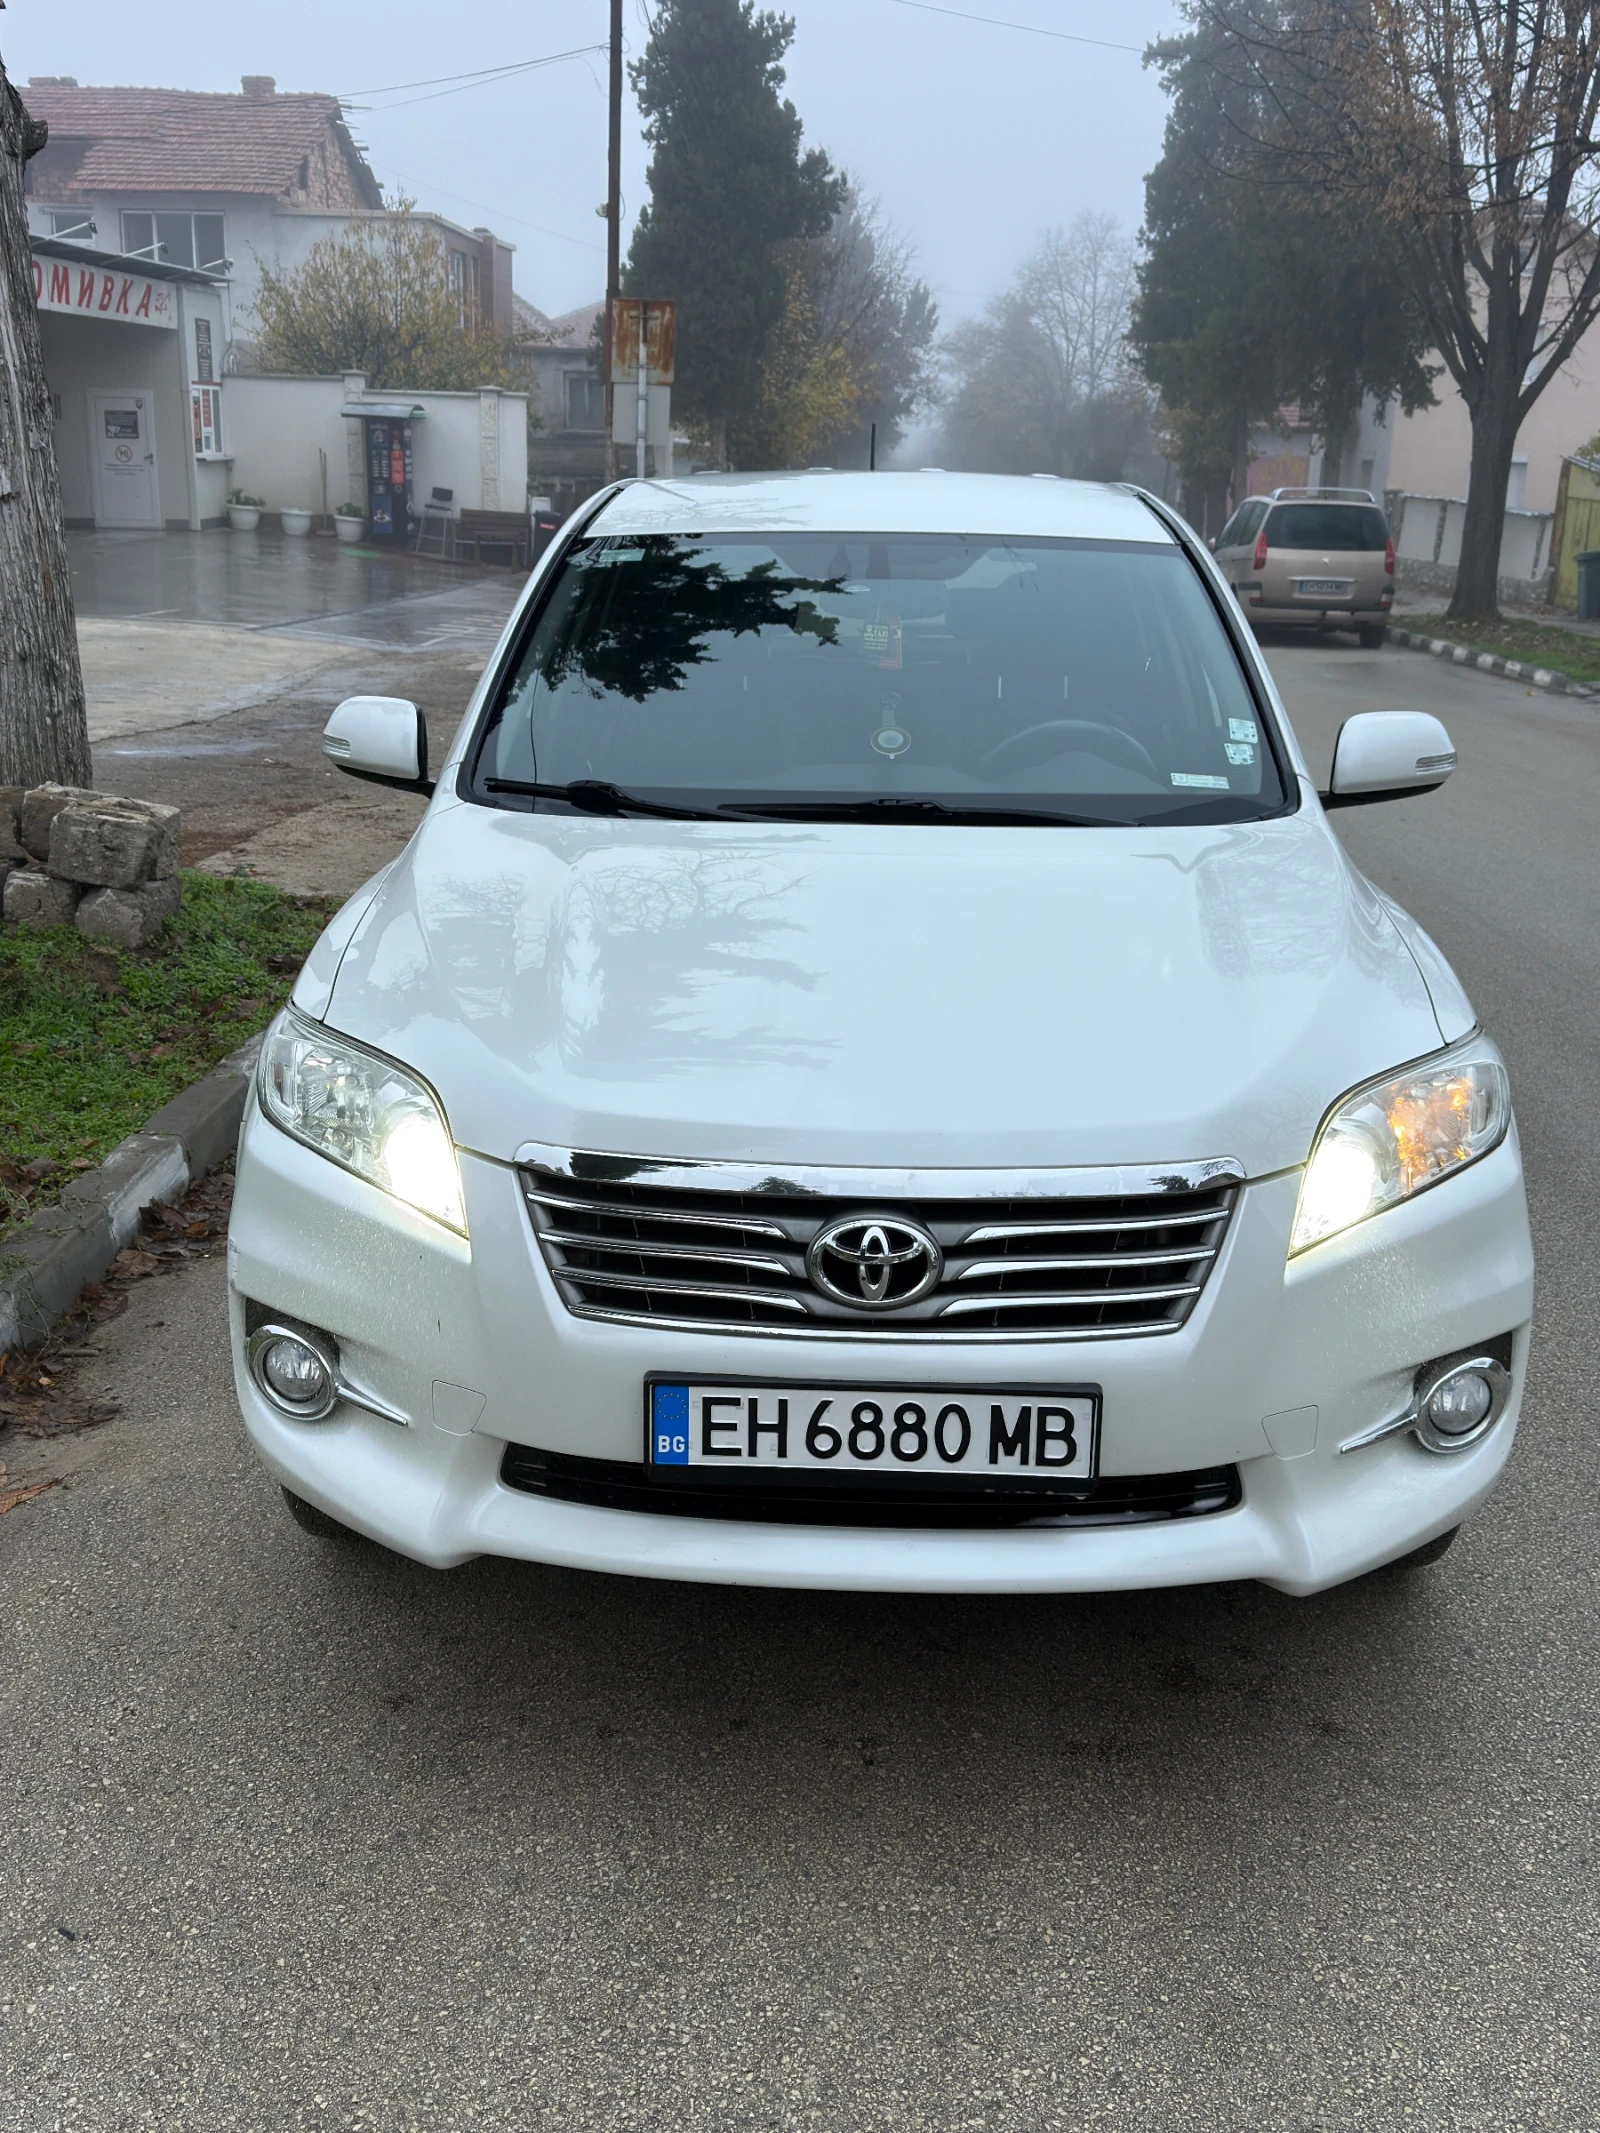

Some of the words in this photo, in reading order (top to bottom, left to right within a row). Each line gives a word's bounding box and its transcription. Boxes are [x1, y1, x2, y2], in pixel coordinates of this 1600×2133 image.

[657, 1435, 686, 1453] BG
[702, 1396, 789, 1458] EH
[805, 1399, 972, 1464] 6880
[988, 1404, 1077, 1467] MB
